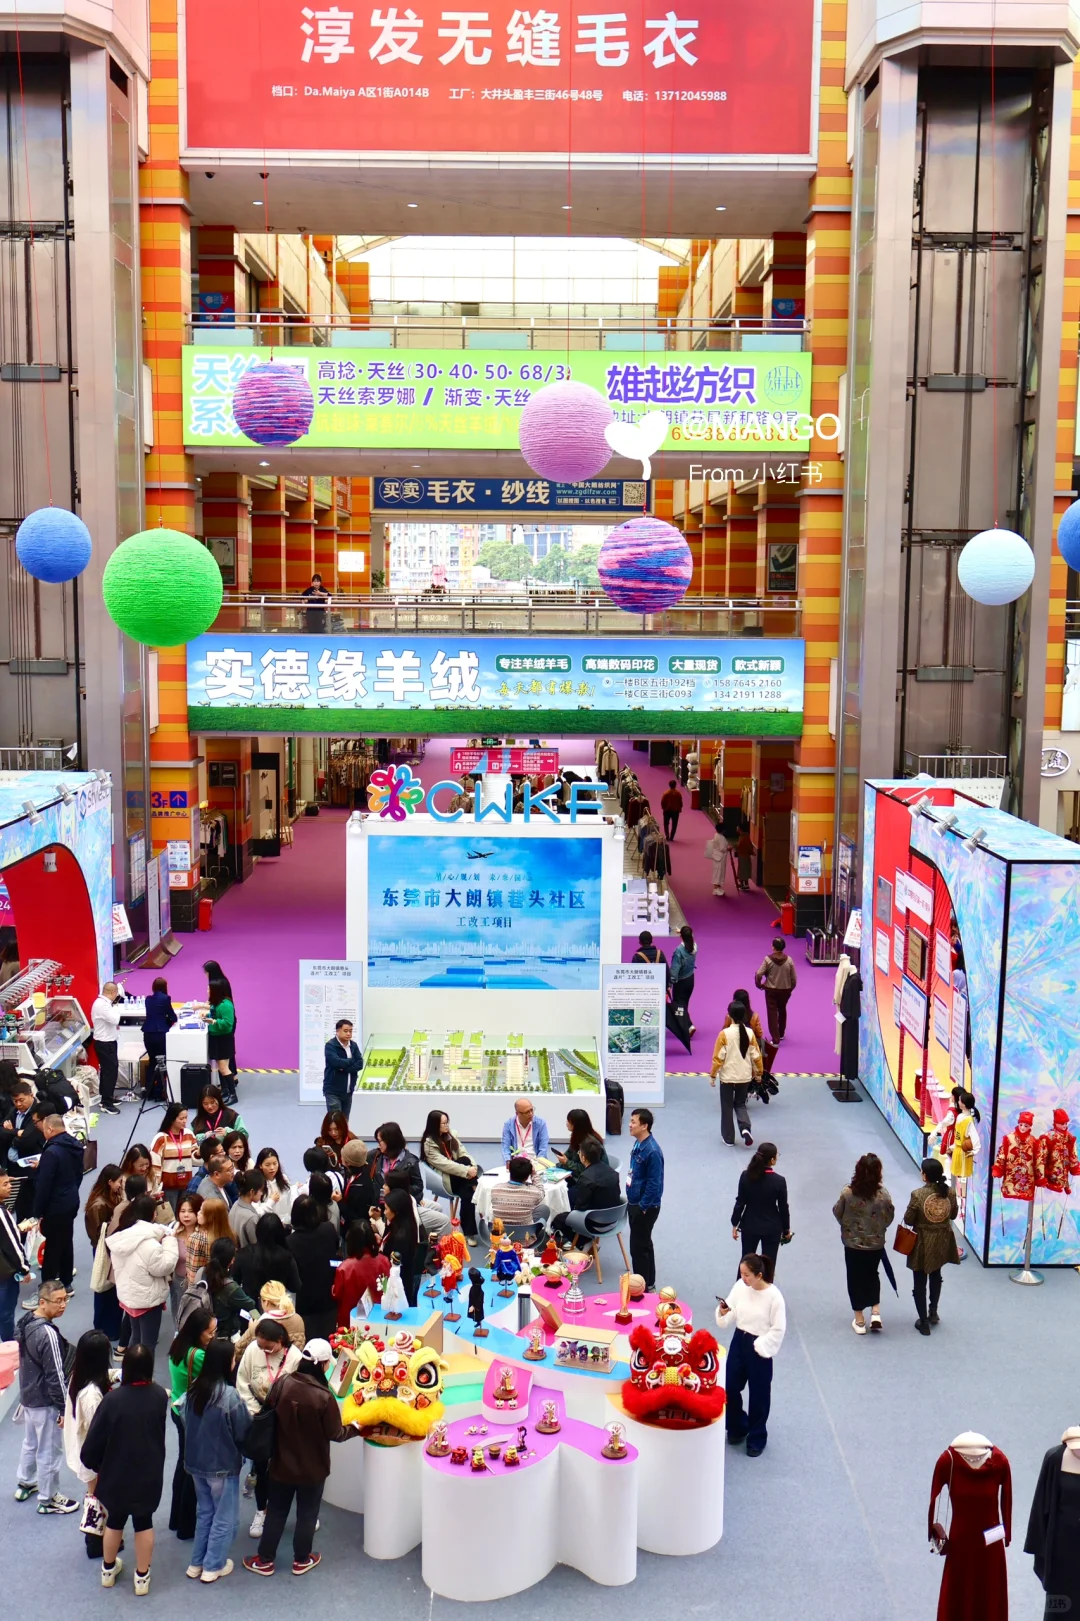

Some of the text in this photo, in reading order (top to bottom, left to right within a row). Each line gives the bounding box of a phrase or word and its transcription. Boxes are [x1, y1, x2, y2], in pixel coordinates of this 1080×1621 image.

[300, 6, 699, 69] 淳发无缝毛衣
[606, 365, 757, 405] 雄越纺织
[317, 387, 416, 406] 天丝索罗娜
[382, 481, 420, 500] 买卖
[499, 657, 569, 670] 专注羊绒羊毛
[585, 658, 656, 671] 高端数码印花
[671, 659, 719, 672] 大量现货
[734, 659, 782, 672] 款式新颖
[204, 648, 482, 702] 实德缘羊绒
[614, 678, 696, 688] 一楼B区五街192档
[713, 679, 782, 688] 158 7645 2160
[614, 690, 693, 699] 一楼C区三街C093
[713, 690, 782, 699] 134 2191 1288
[151, 791, 168, 808] 3F
[426, 780, 609, 824] CWKF
[382, 887, 586, 909] 东莞市大朗镇巷头社区
[456, 916, 512, 928] 工改工项目
